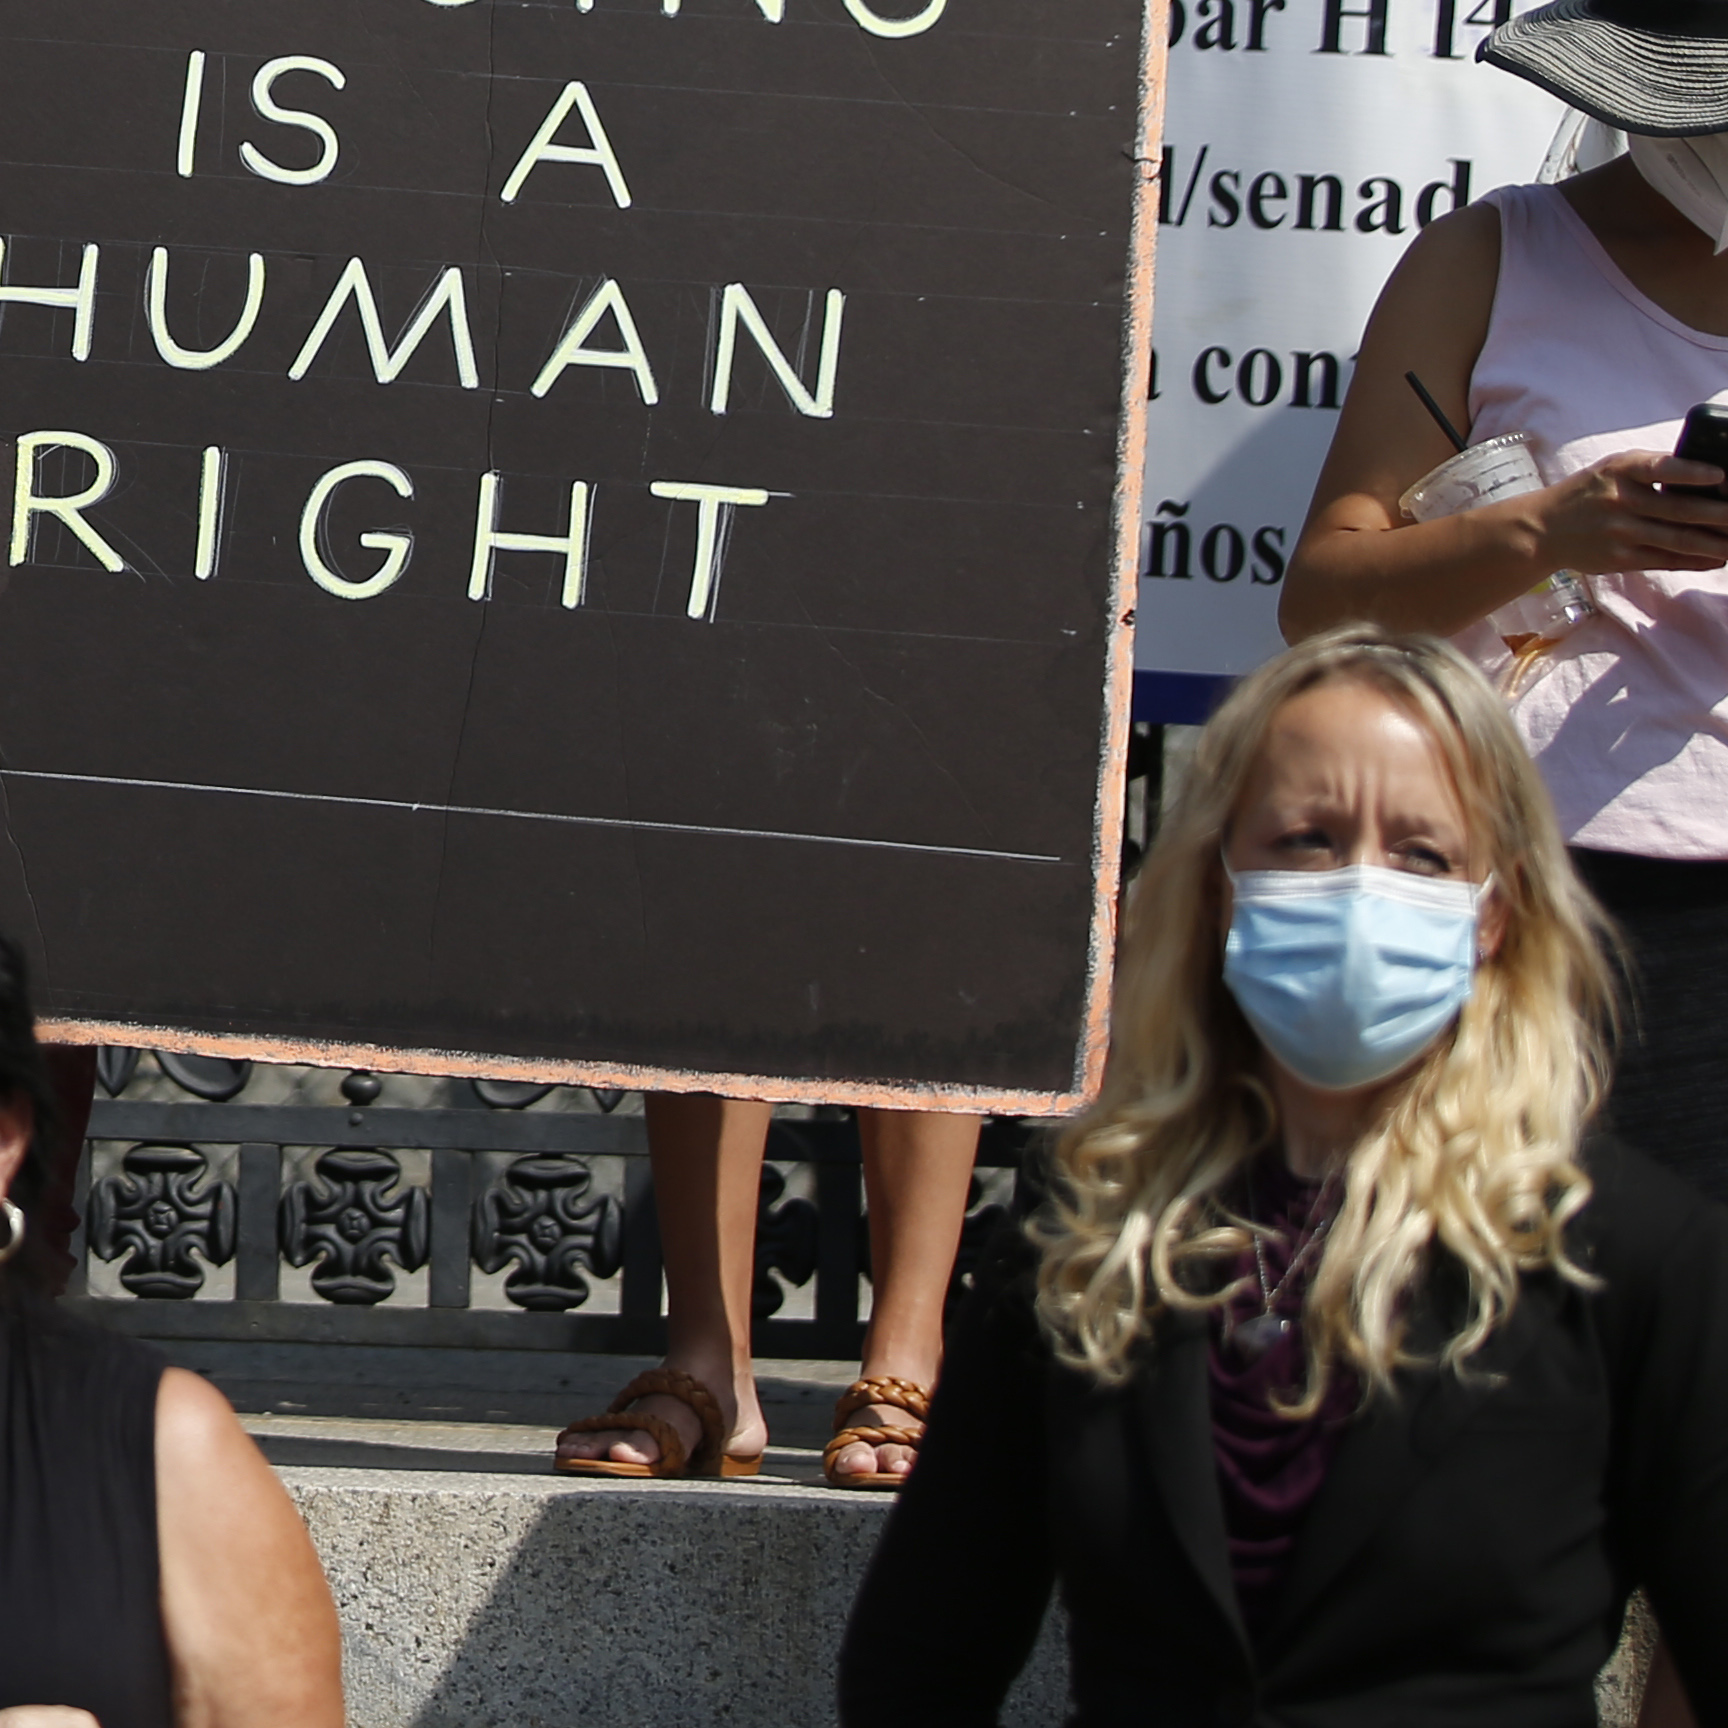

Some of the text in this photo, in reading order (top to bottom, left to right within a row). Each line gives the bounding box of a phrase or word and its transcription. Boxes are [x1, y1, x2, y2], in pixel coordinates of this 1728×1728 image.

[178, 51, 633, 208] IS A
[9, 429, 771, 622] RIGHT
